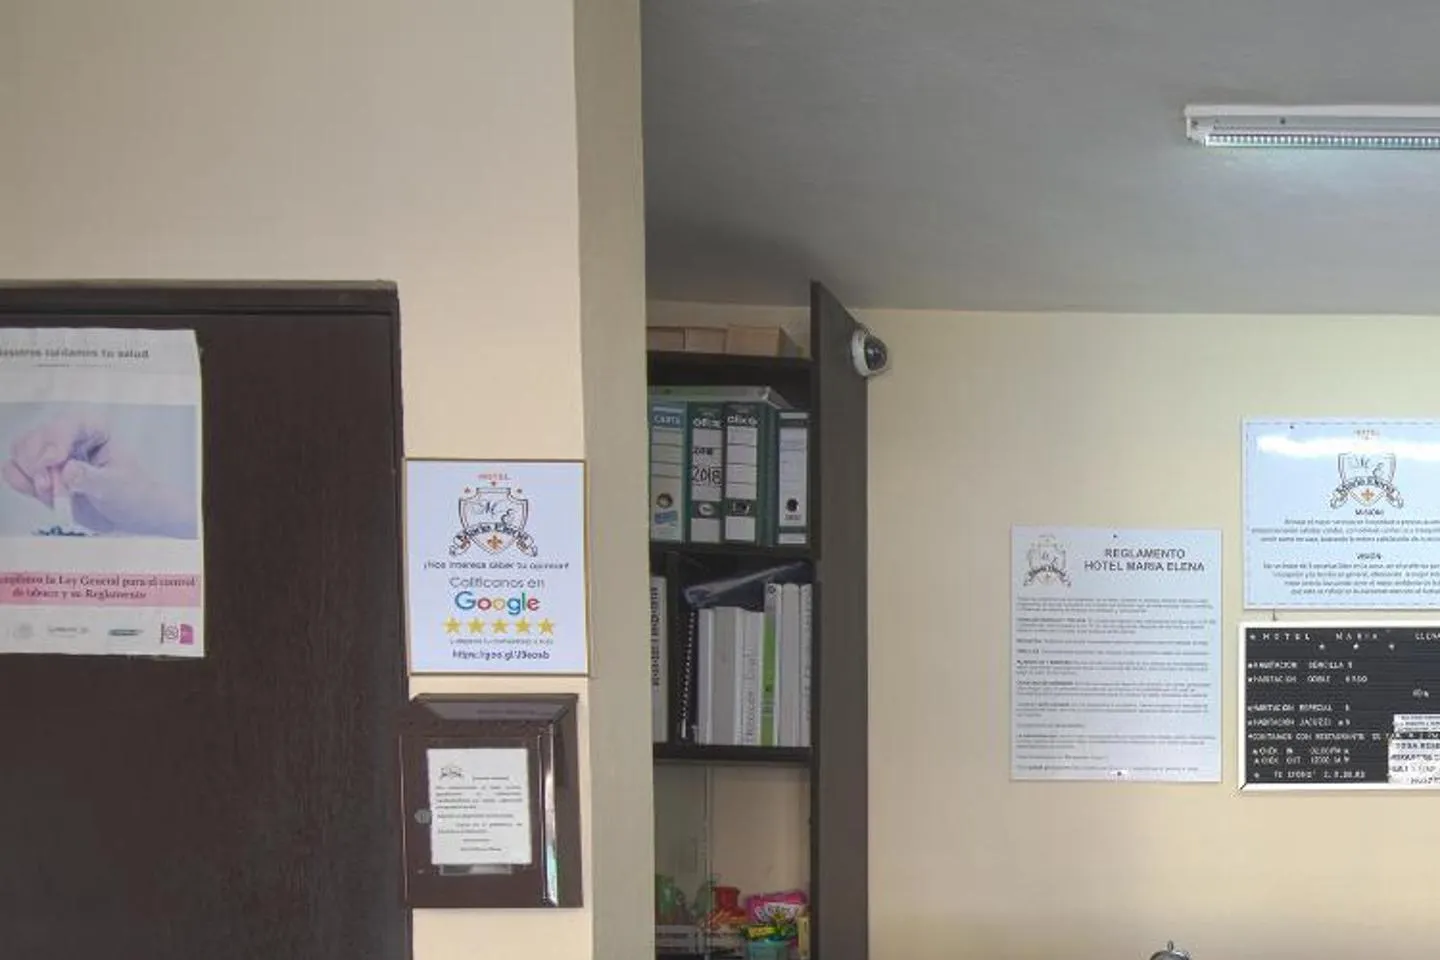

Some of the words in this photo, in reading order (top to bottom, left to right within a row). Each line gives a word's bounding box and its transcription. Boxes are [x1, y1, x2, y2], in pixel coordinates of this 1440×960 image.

[1105, 549, 1186, 559] REGLAMENTO
[1084, 561, 1123, 571] HOTEL
[1167, 561, 1205, 572] ELENA
[80, 575, 119, 586] General
[454, 590, 541, 616] Google
